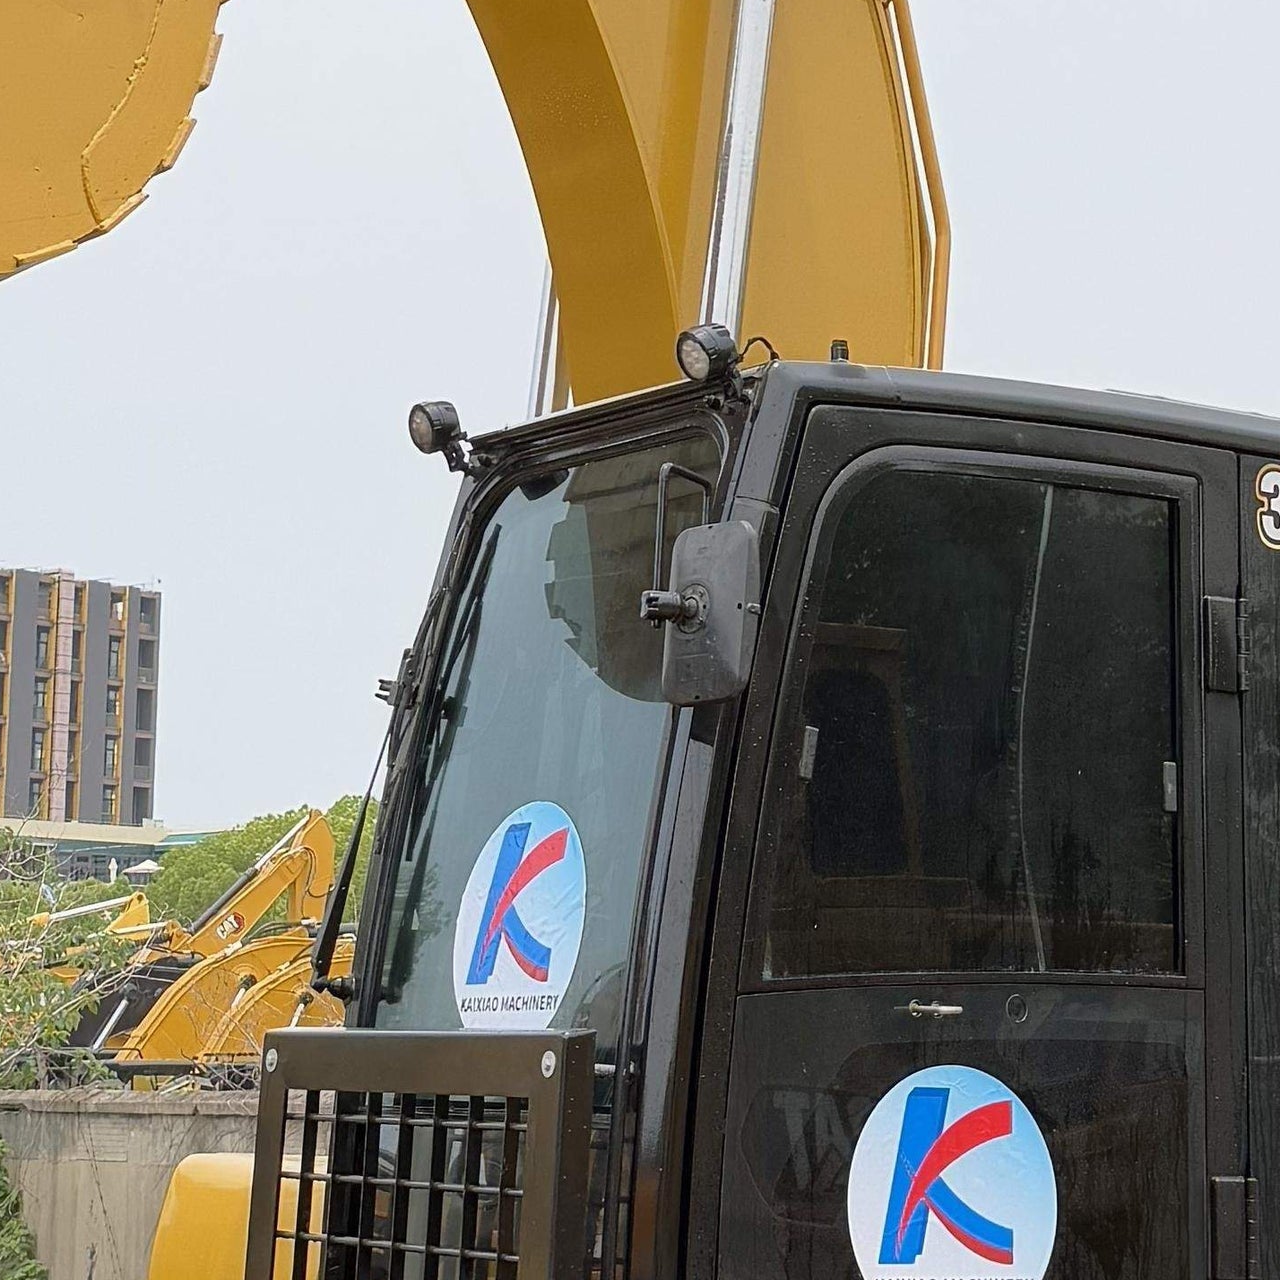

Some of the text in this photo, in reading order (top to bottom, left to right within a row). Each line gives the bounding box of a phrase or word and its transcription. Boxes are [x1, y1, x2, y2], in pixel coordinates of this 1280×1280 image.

[216, 914, 239, 940] CAT
[460, 994, 560, 1013] KAIXIAO MACHINERY
